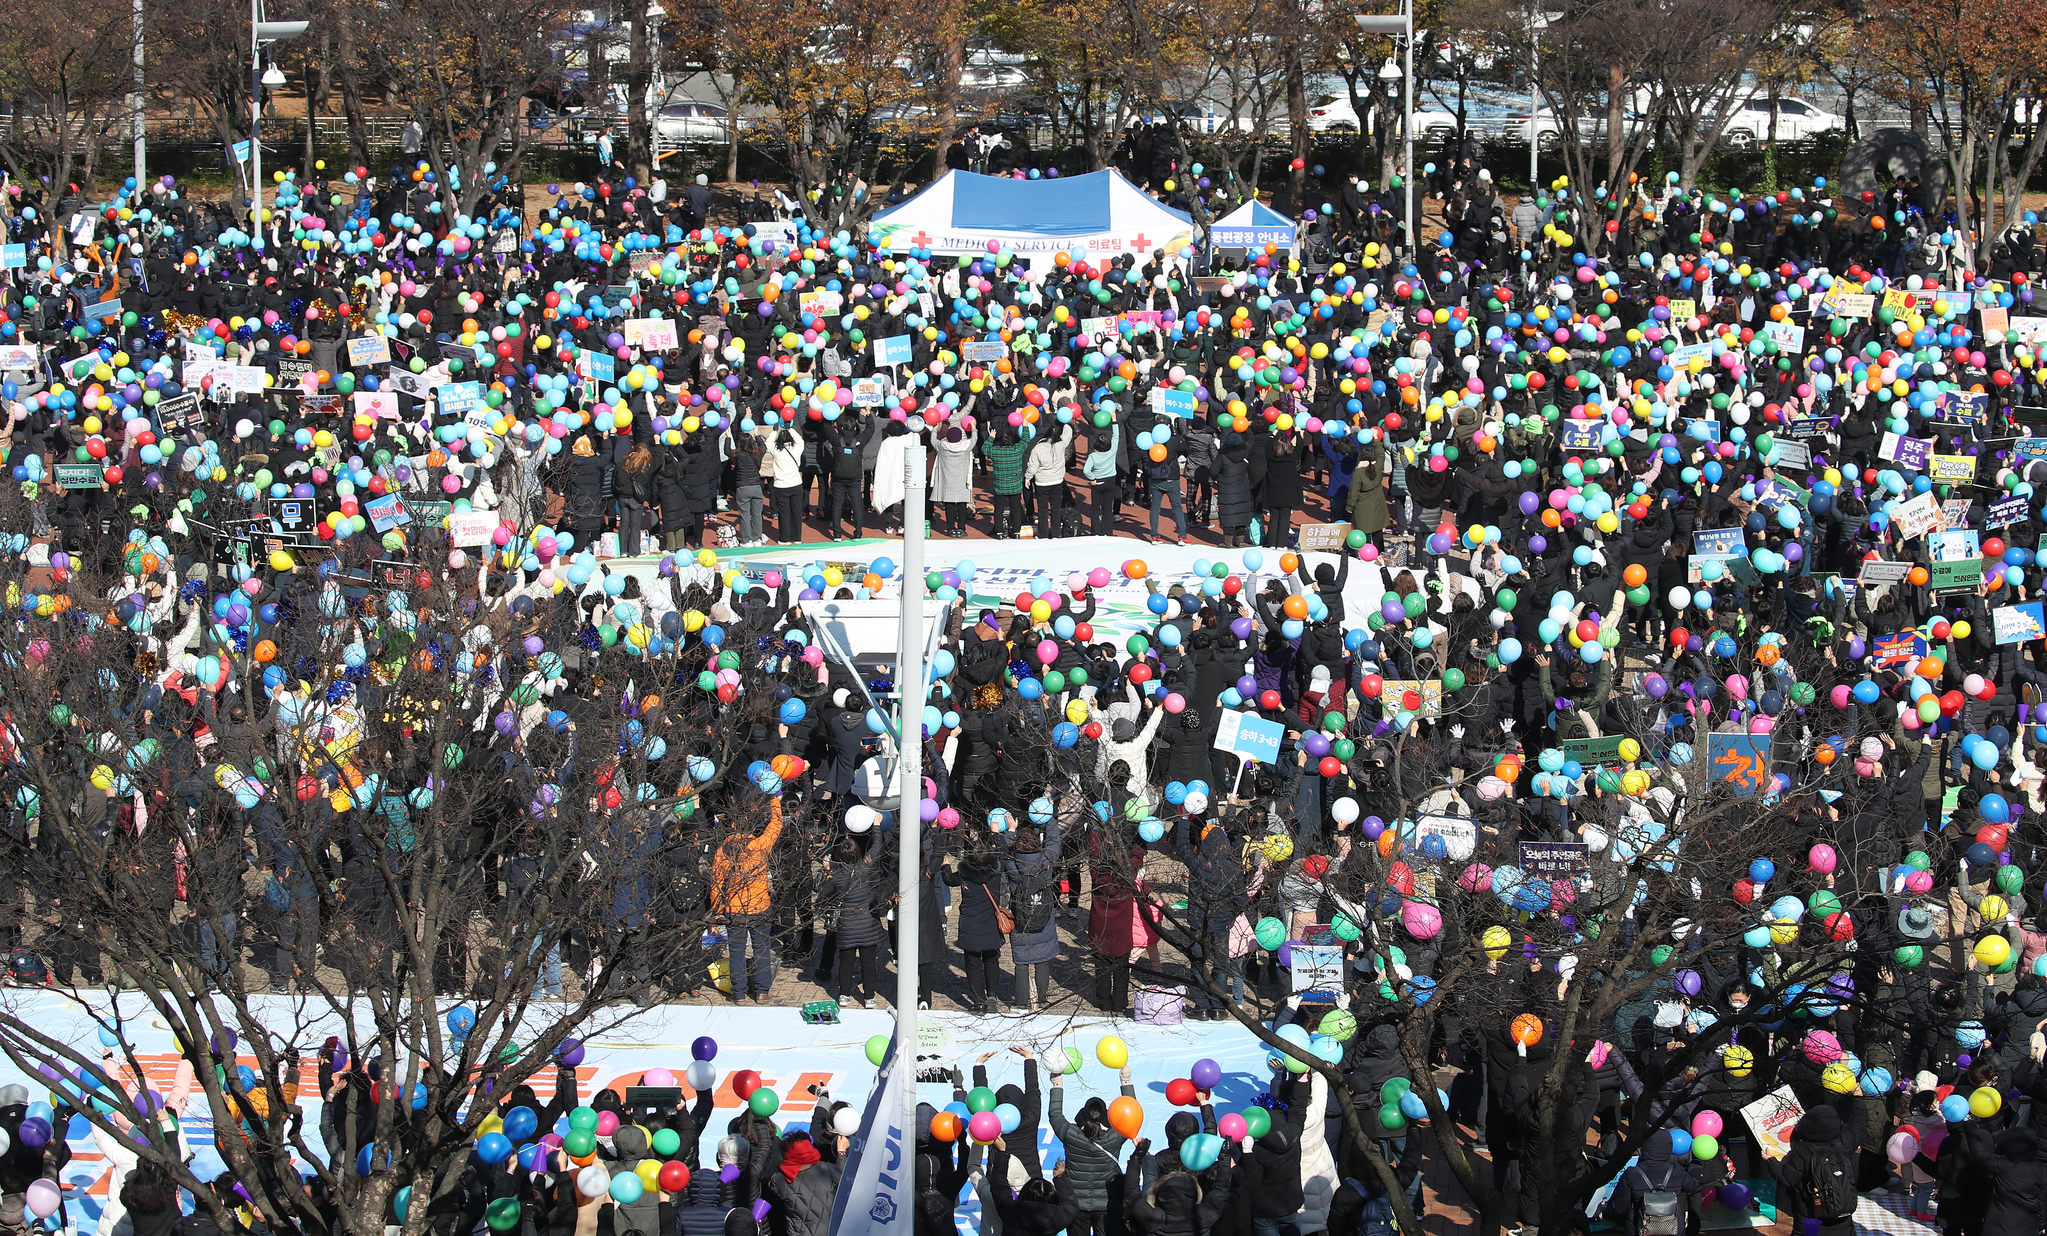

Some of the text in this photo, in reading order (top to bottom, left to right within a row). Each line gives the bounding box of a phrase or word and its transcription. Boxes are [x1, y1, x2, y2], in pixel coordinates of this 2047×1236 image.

[1211, 231, 1291, 244] 동편광장 안내소
[940, 236, 1076, 251] MEDICL SERVICE
[1088, 238, 1121, 251] 의료팀
[648, 333, 672, 349] 축제
[1165, 399, 1193, 411] 여수 2-29
[1955, 408, 1973, 416] 수료
[1573, 438, 1590, 447] 수료
[1903, 440, 1924, 453] 전주
[1899, 453, 1920, 466] 5-61
[58, 468, 90, 477] 멋지다!
[60, 476, 100, 485] 십만수료!
[1306, 527, 1341, 538] 하늘에
[1305, 537, 1339, 548] 영광을
[1932, 567, 1952, 575] 수료에
[1953, 573, 1980, 583] 진심인편
[1882, 647, 1914, 658] 바로 당신
[1239, 727, 1279, 748] 송하 3-43
[1591, 749, 1620, 759] 진심인
[1525, 850, 1583, 861] 오늘의 주인공은
[1538, 861, 1556, 871] 바로
